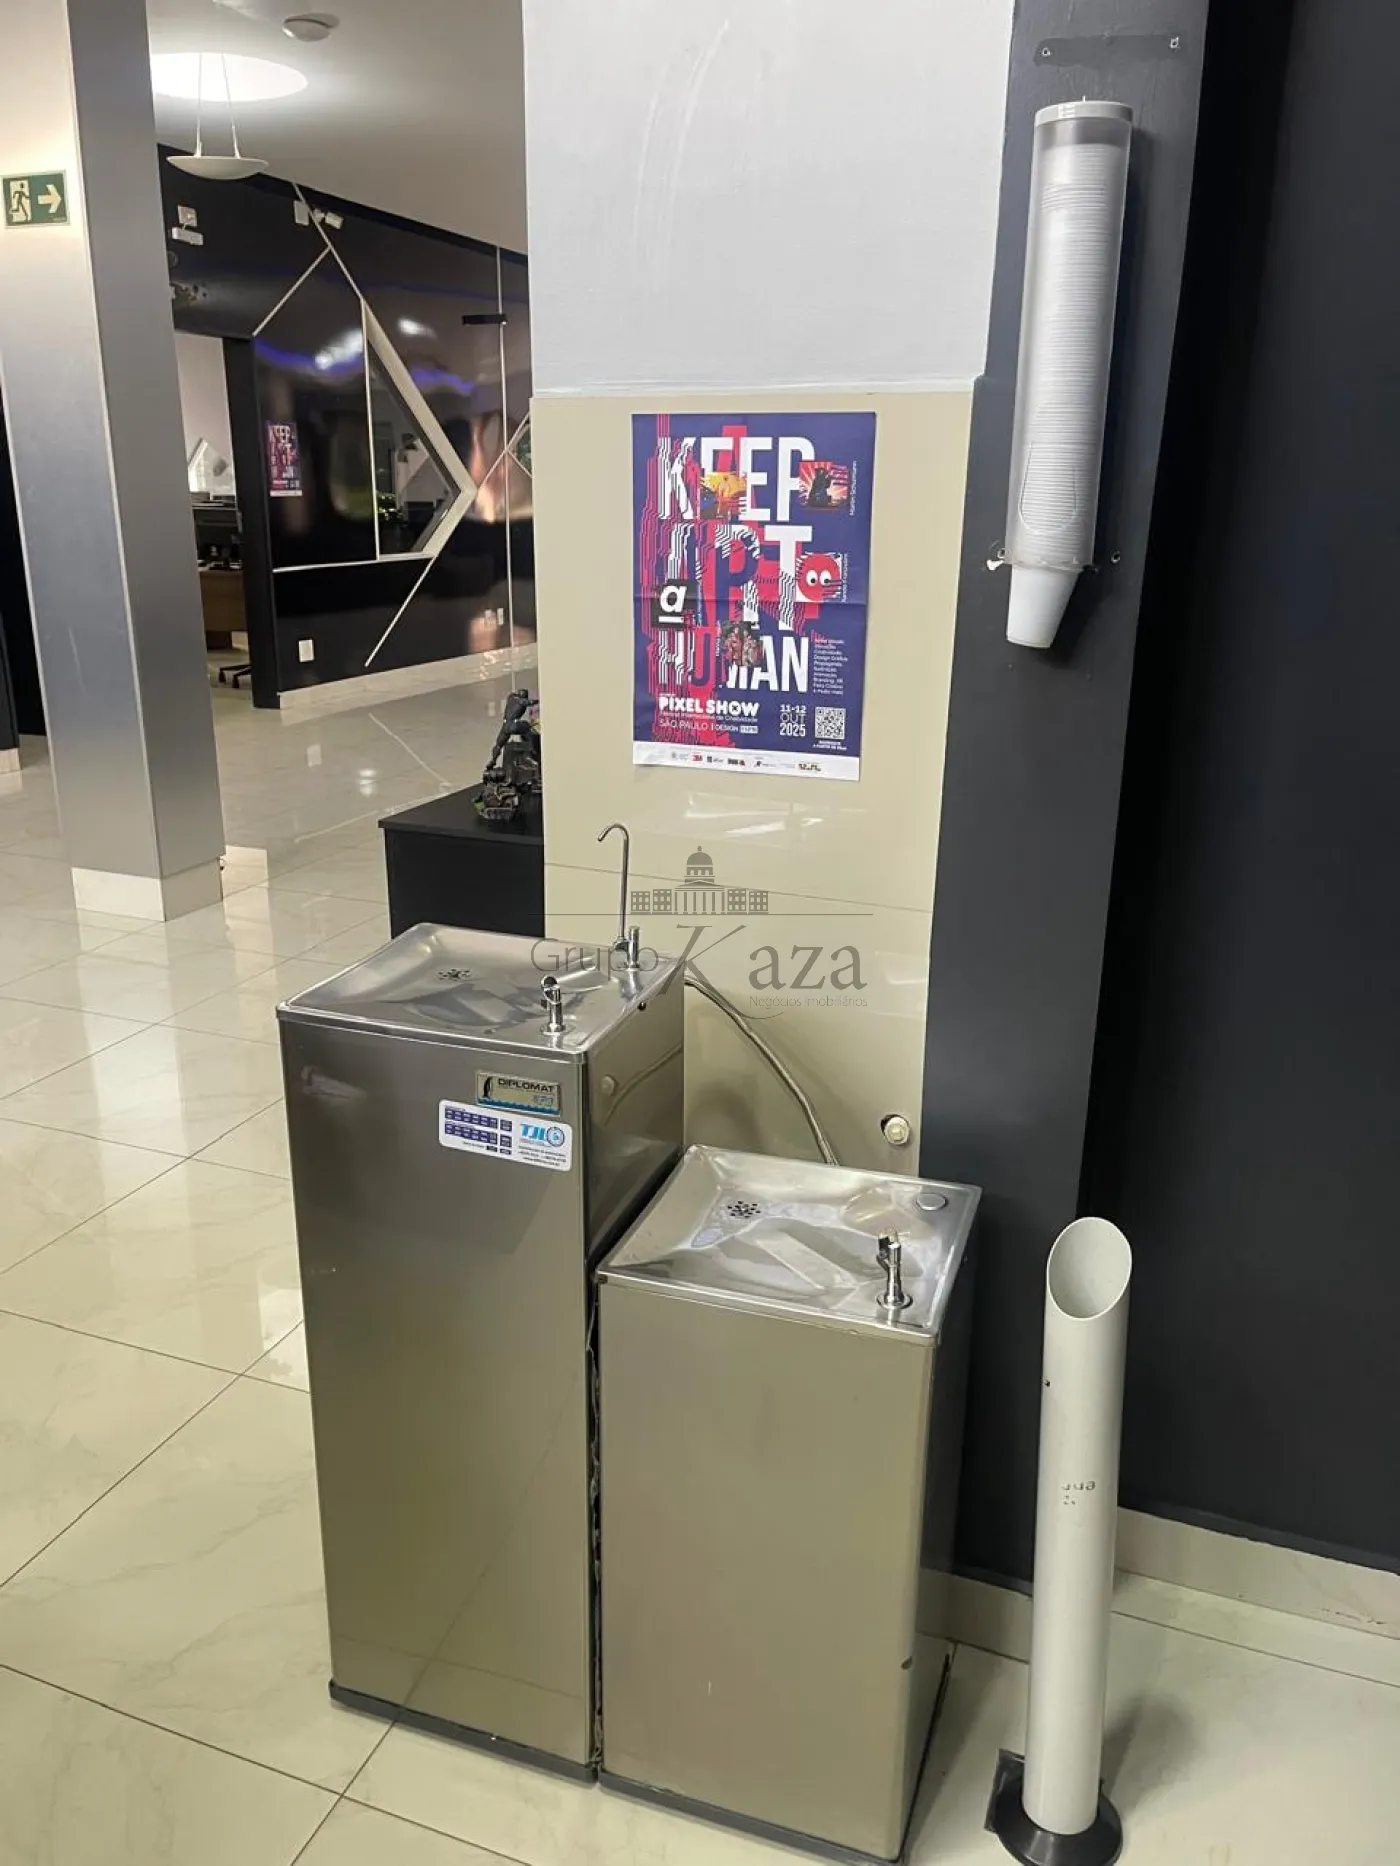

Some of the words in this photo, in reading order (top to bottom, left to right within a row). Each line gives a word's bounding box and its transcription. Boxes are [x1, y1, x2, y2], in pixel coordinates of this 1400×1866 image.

[658, 696, 703, 714] PIXEL
[706, 700, 760, 717] SHOW
[780, 704, 807, 714] 11-12
[780, 712, 807, 724] OUT
[679, 719, 708, 731] PAULO
[779, 723, 806, 737] 2025
[497, 1077, 555, 1094] DIPLOMAT
